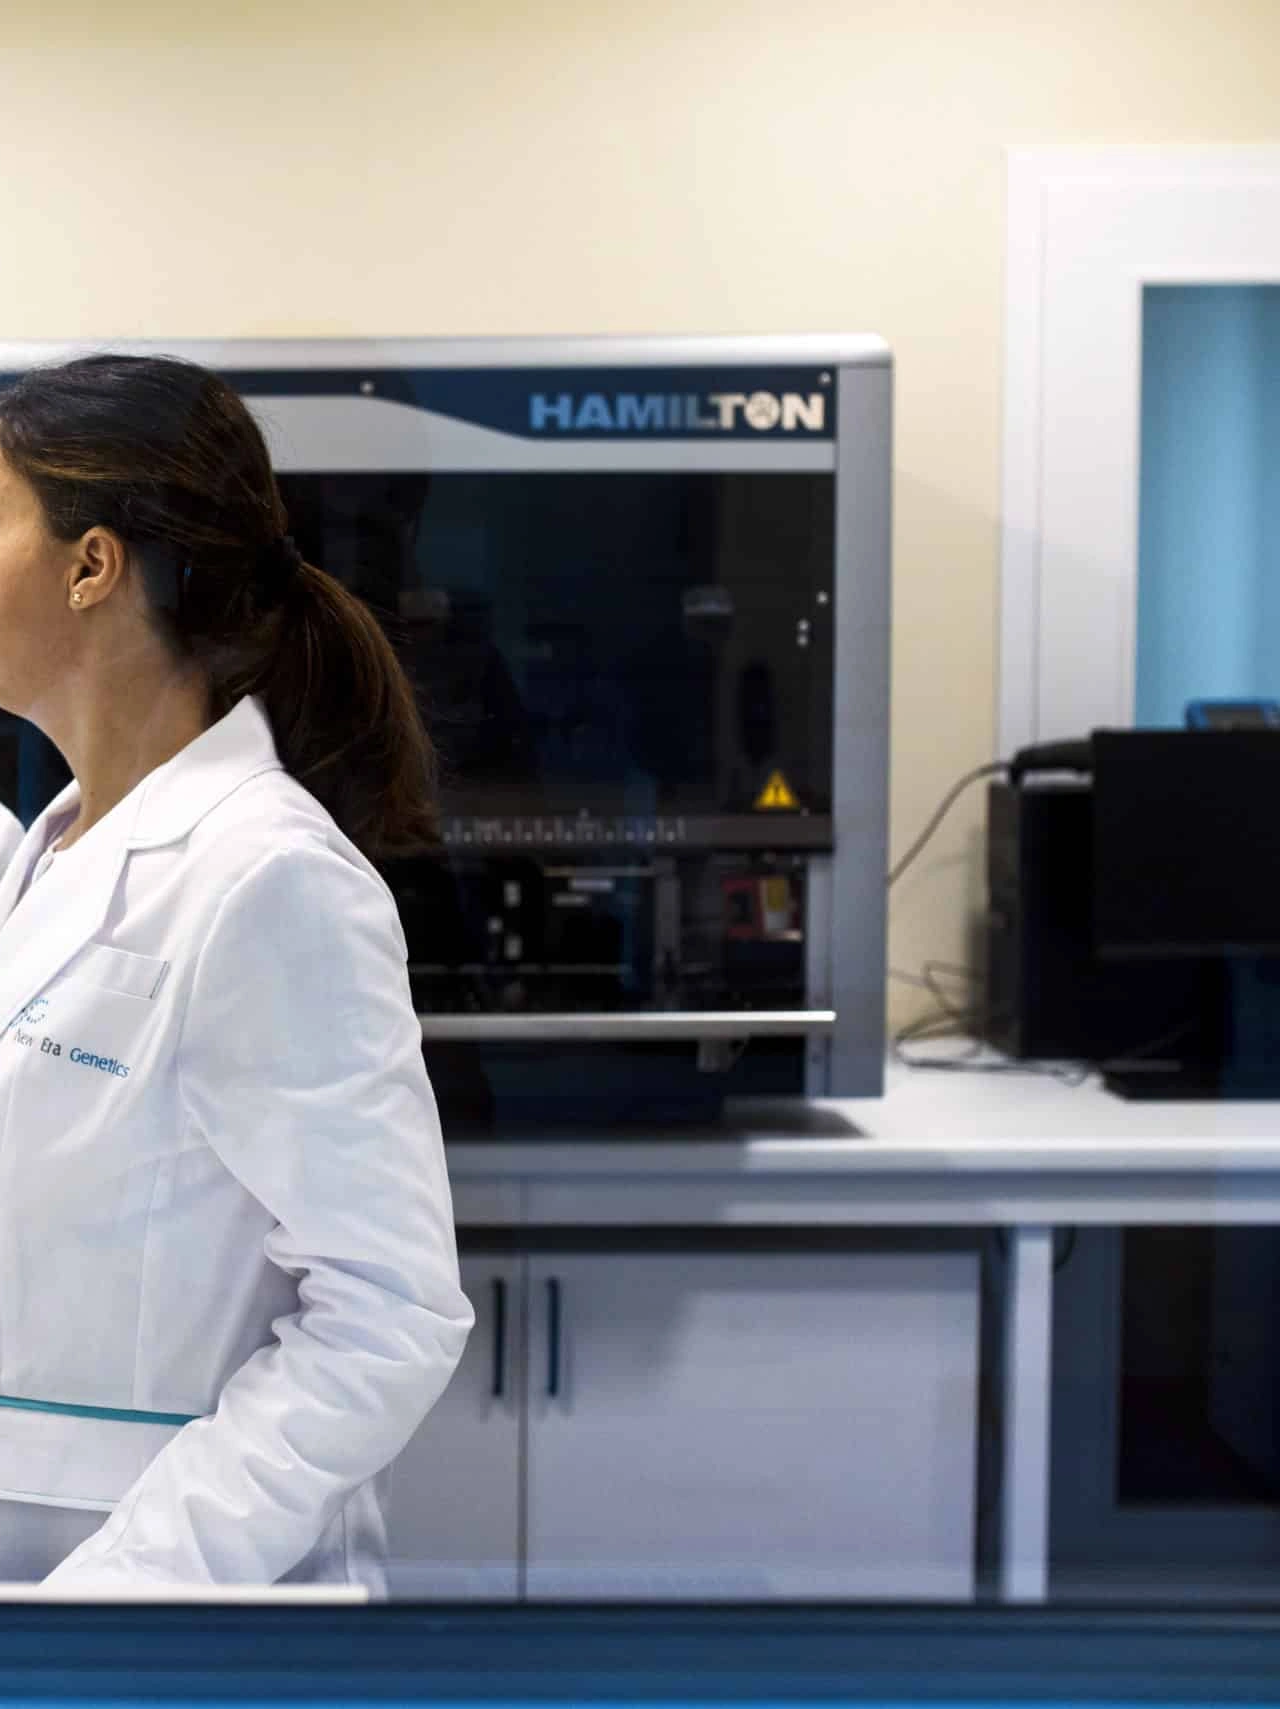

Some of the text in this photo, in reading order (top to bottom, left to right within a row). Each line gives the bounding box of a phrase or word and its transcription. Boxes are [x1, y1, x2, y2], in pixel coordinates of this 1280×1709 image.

[529, 391, 825, 431] HAMILTON
[40, 1037, 62, 1056] Era
[70, 1047, 130, 1078] Genetics
